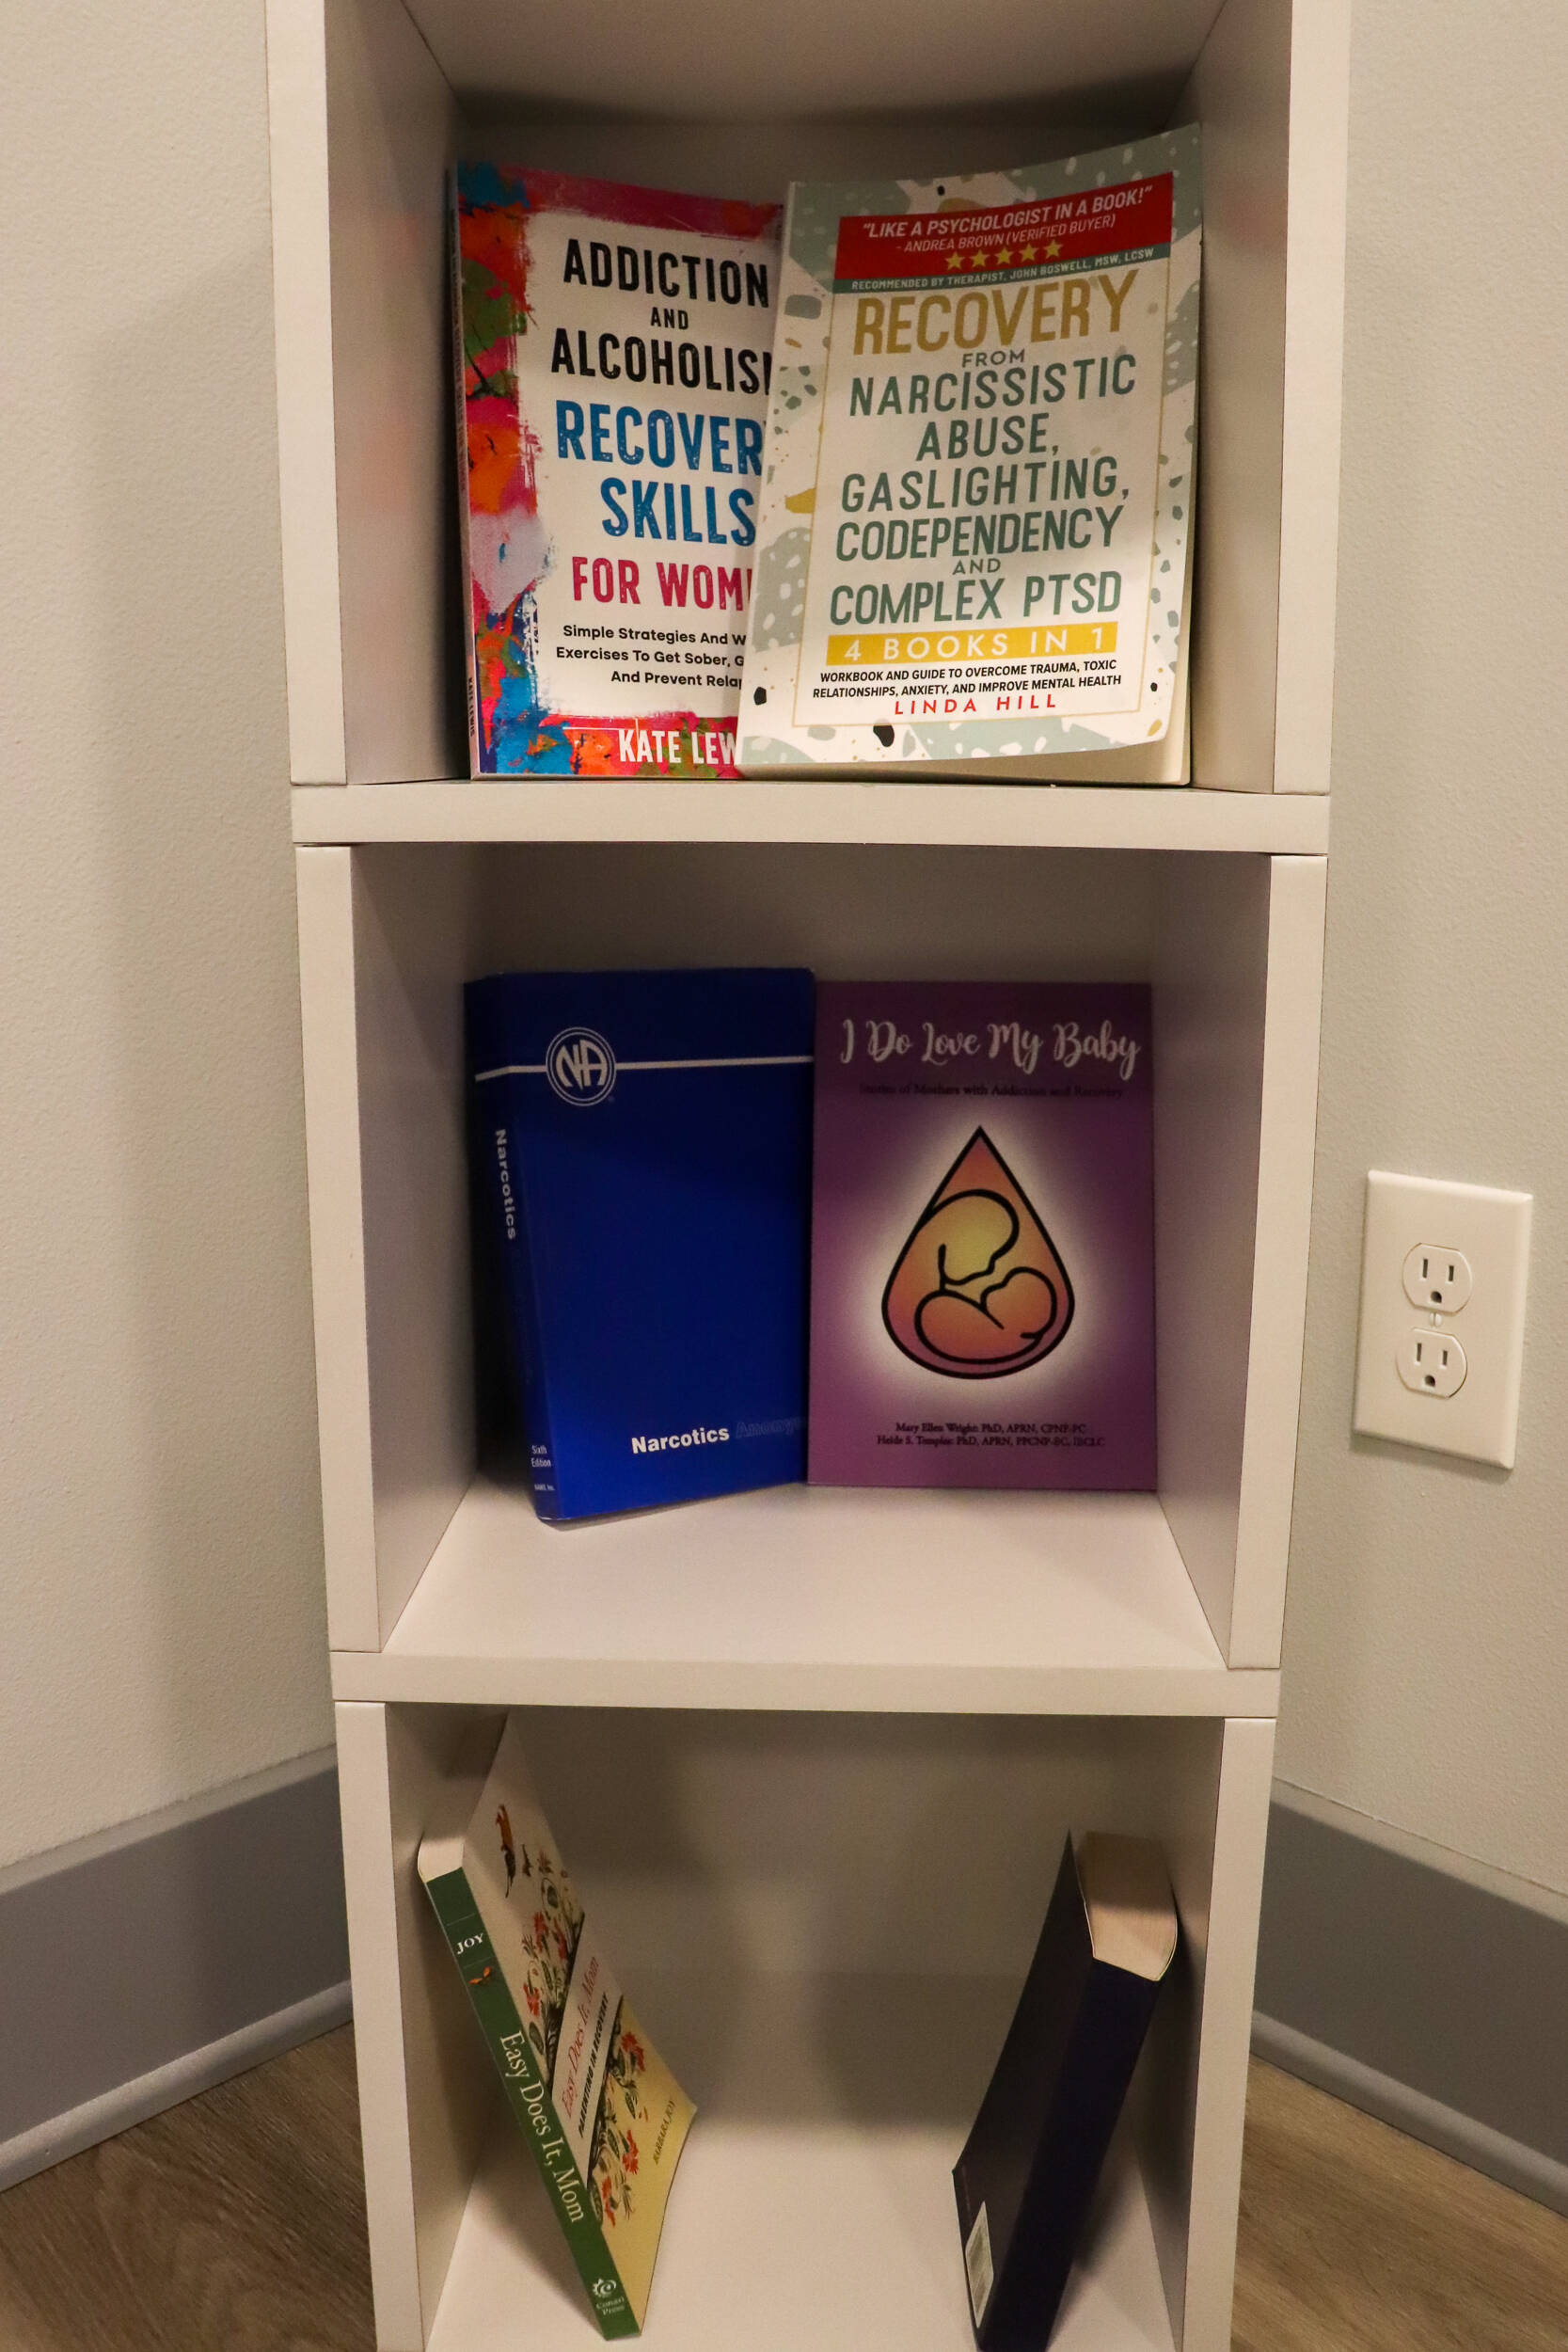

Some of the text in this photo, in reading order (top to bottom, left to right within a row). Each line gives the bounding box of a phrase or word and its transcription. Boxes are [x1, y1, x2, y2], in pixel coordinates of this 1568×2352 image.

[903, 236, 957, 253] ANDREA
[958, 230, 1006, 250] BROWN
[1006, 223, 1068, 246] (VERIFIED
[1069, 213, 1117, 235] BUYER)
[911, 219, 924, 236] A
[927, 204, 1053, 236] PSYCHOLOGIST
[1054, 201, 1071, 220] IN
[1073, 199, 1087, 216] A
[563, 238, 769, 309] ADDICTION
[852, 277, 929, 291] RECOMMENDED
[930, 276, 945, 288] BY
[1009, 266, 1037, 280] JOHN
[1040, 260, 1093, 278] BOSWELL,
[1095, 254, 1122, 268] MSW,
[1124, 246, 1155, 263] LCSW
[650, 307, 689, 330] AND
[853, 269, 1140, 357] RECOVERY
[961, 349, 1026, 369] FROM
[849, 354, 1136, 417] NARCISSISTIC
[555, 399, 767, 476] RECOVER
[916, 412, 1059, 462] ABUSE,
[842, 456, 1130, 513] GASLIGHTING,
[600, 477, 756, 548] SKILLS
[836, 504, 1125, 563] CODEPENDENCY
[572, 556, 641, 605] FOR
[952, 558, 1001, 576] AND
[830, 570, 1122, 626] COMPLEX PTSD
[562, 625, 614, 641] Simple
[618, 628, 696, 644] Strategies
[700, 632, 728, 644] And
[844, 628, 1103, 661] 4 BOOKS IN 1
[556, 646, 628, 661] Exercises
[632, 650, 650, 662] To
[654, 651, 681, 664] Get
[685, 652, 731, 668] Sober,
[820, 659, 1117, 683] WORKBOOK AND GUIDE TO OVERCOME TRAUMA, TOXIC
[611, 670, 641, 683] And
[644, 672, 703, 687] Prevent
[813, 674, 1122, 698] RELATIONSHIPS, ANXIETY, AND IMPROVE MENTAL HEALTH
[895, 693, 1057, 716] LINDA HILL
[618, 729, 682, 764] KATE
[555, 1039, 609, 1091] NA
[840, 1019, 1142, 1081] I Do Love My Baby
[914, 1085, 960, 1097] Mothers
[962, 1085, 989, 1096] with
[496, 1128, 516, 1240] Narcotics
[631, 1427, 730, 1454] Narcotics
[895, 1422, 919, 1434] Mary
[922, 1422, 943, 1433] Ellen
[981, 1422, 1004, 1434] PhD,
[1006, 1422, 1037, 1434] APRN,
[956, 1436, 979, 1447] PhD,
[981, 1436, 1013, 1448] APRN,
[531, 1445, 547, 1455] Sixth
[531, 1457, 551, 1469] Edition
[456, 1932, 484, 1956] JOY
[581, 1956, 600, 2003] Mom
[568, 2026, 585, 2073] Does
[578, 1991, 610, 2138] PARENTING IN RECOVERY
[561, 2077, 578, 2119] Easy
[499, 2030, 586, 2223] Easy Does It, Mom
